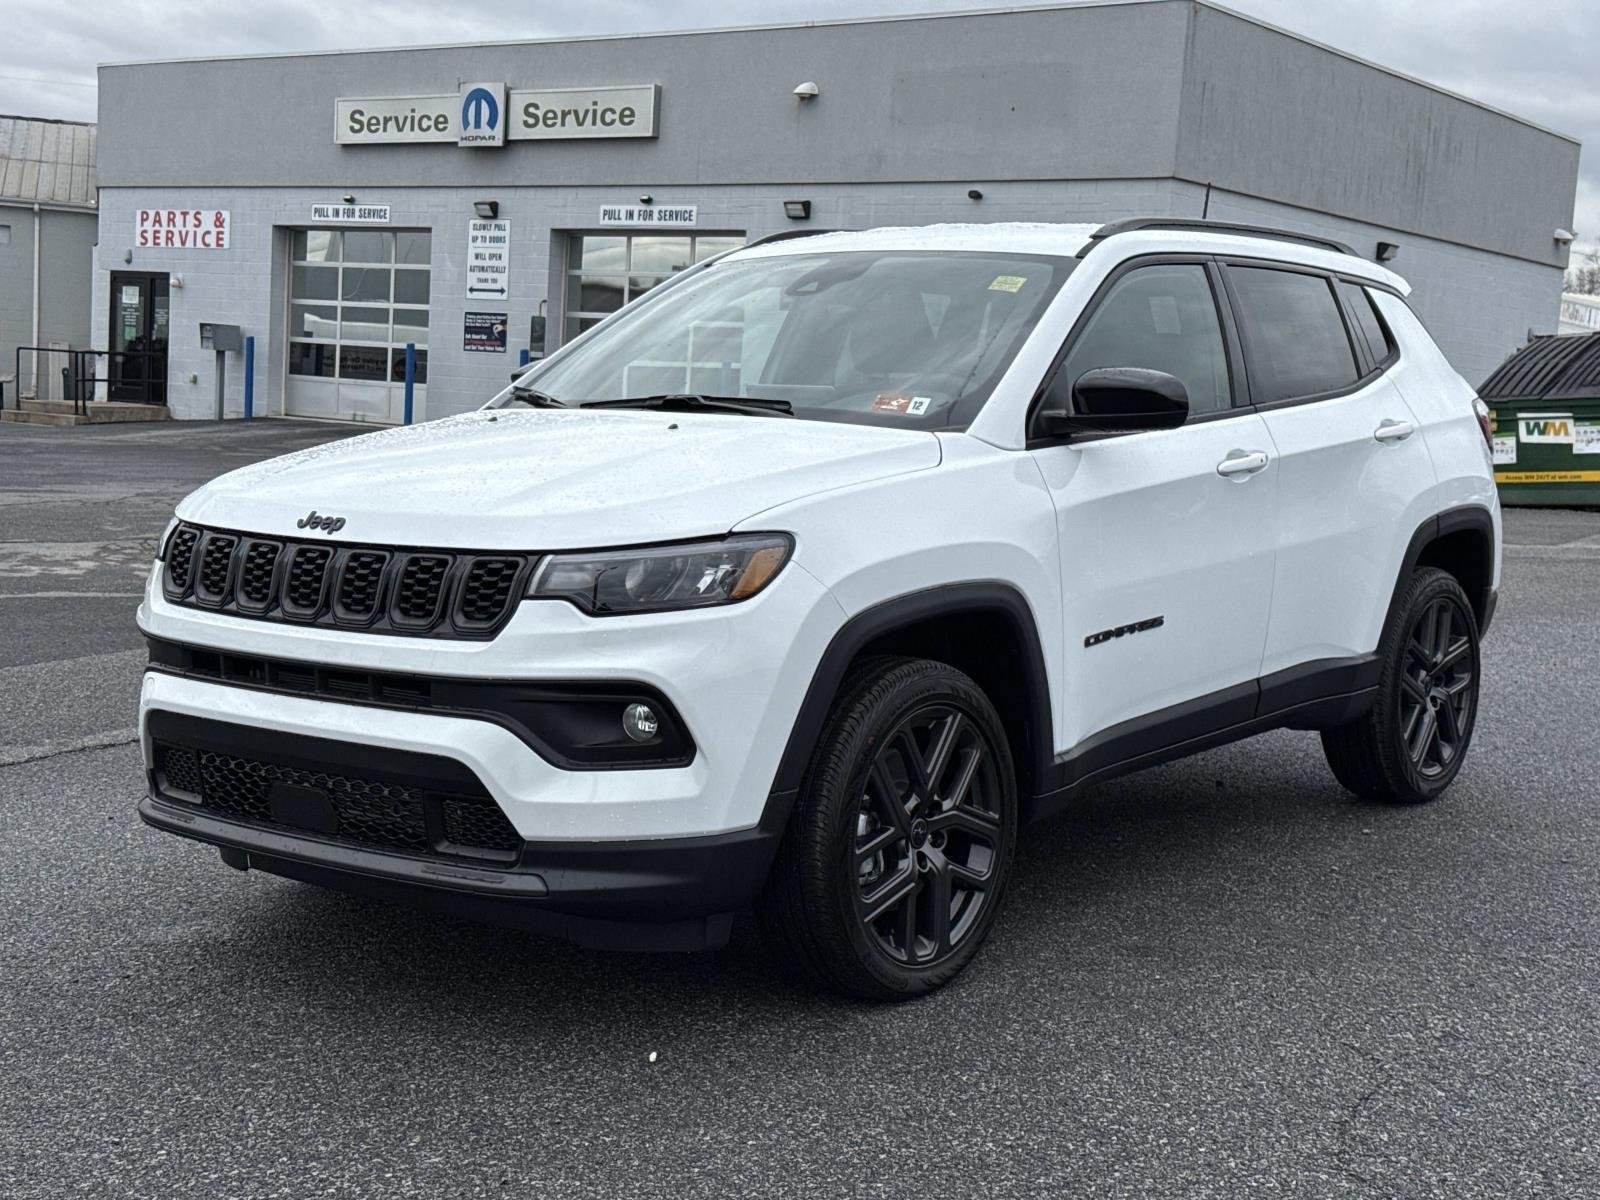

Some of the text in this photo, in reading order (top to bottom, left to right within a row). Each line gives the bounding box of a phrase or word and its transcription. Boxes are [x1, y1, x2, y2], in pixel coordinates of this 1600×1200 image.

[349, 108, 449, 134] Service
[522, 101, 636, 129] Service
[140, 211, 225, 228] PARTS &
[313, 207, 388, 220] PULL IN FOR SERVICE
[602, 209, 694, 222] PULL IN FOR SERVICE
[472, 223, 507, 232] SLOWLY PULL
[140, 229, 225, 248] SERVICE
[471, 235, 479, 243] UP
[480, 235, 487, 244] TO
[474, 253, 502, 261] WILL OPEN
[469, 265, 506, 274] AUTOMATICALLY
[912, 401, 923, 411] 12
[1525, 421, 1569, 436] WM
[296, 510, 347, 535] Jeep
[1084, 615, 1164, 648] COMPASS
